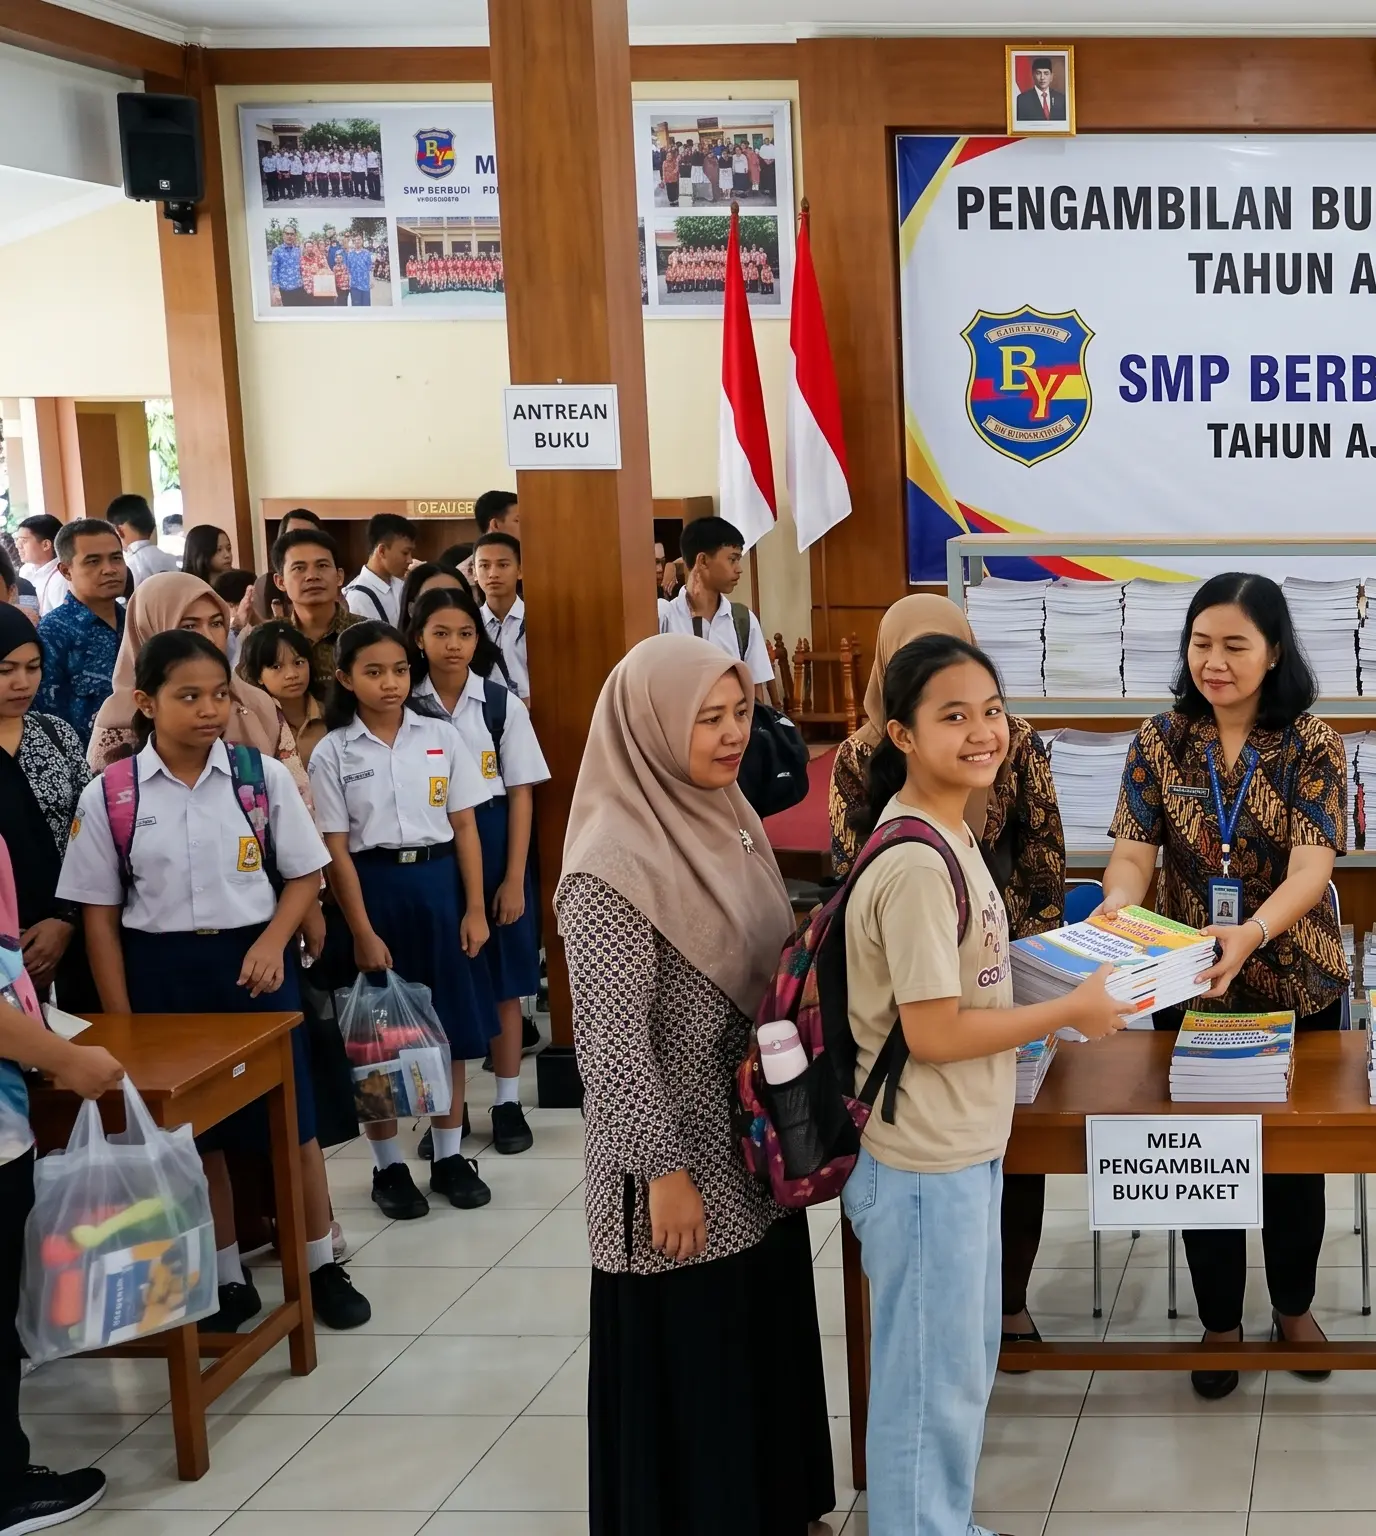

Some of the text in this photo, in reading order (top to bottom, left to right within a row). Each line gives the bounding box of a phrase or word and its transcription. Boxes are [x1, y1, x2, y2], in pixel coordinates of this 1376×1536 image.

[403, 186, 471, 195] SMP BERBUDI
[957, 185, 1292, 231] PENGAMBILAN
[1187, 252, 1333, 296] TAHUN
[1118, 353, 1230, 404] SMP
[512, 403, 608, 420] ANTREAN
[534, 431, 589, 449] BUKU
[1206, 422, 1331, 459] TAHUN
[1147, 1132, 1202, 1149] MEJA
[1099, 1158, 1250, 1175] PENGAMBILAN
[1113, 1183, 1239, 1201] BUKU PAKET
